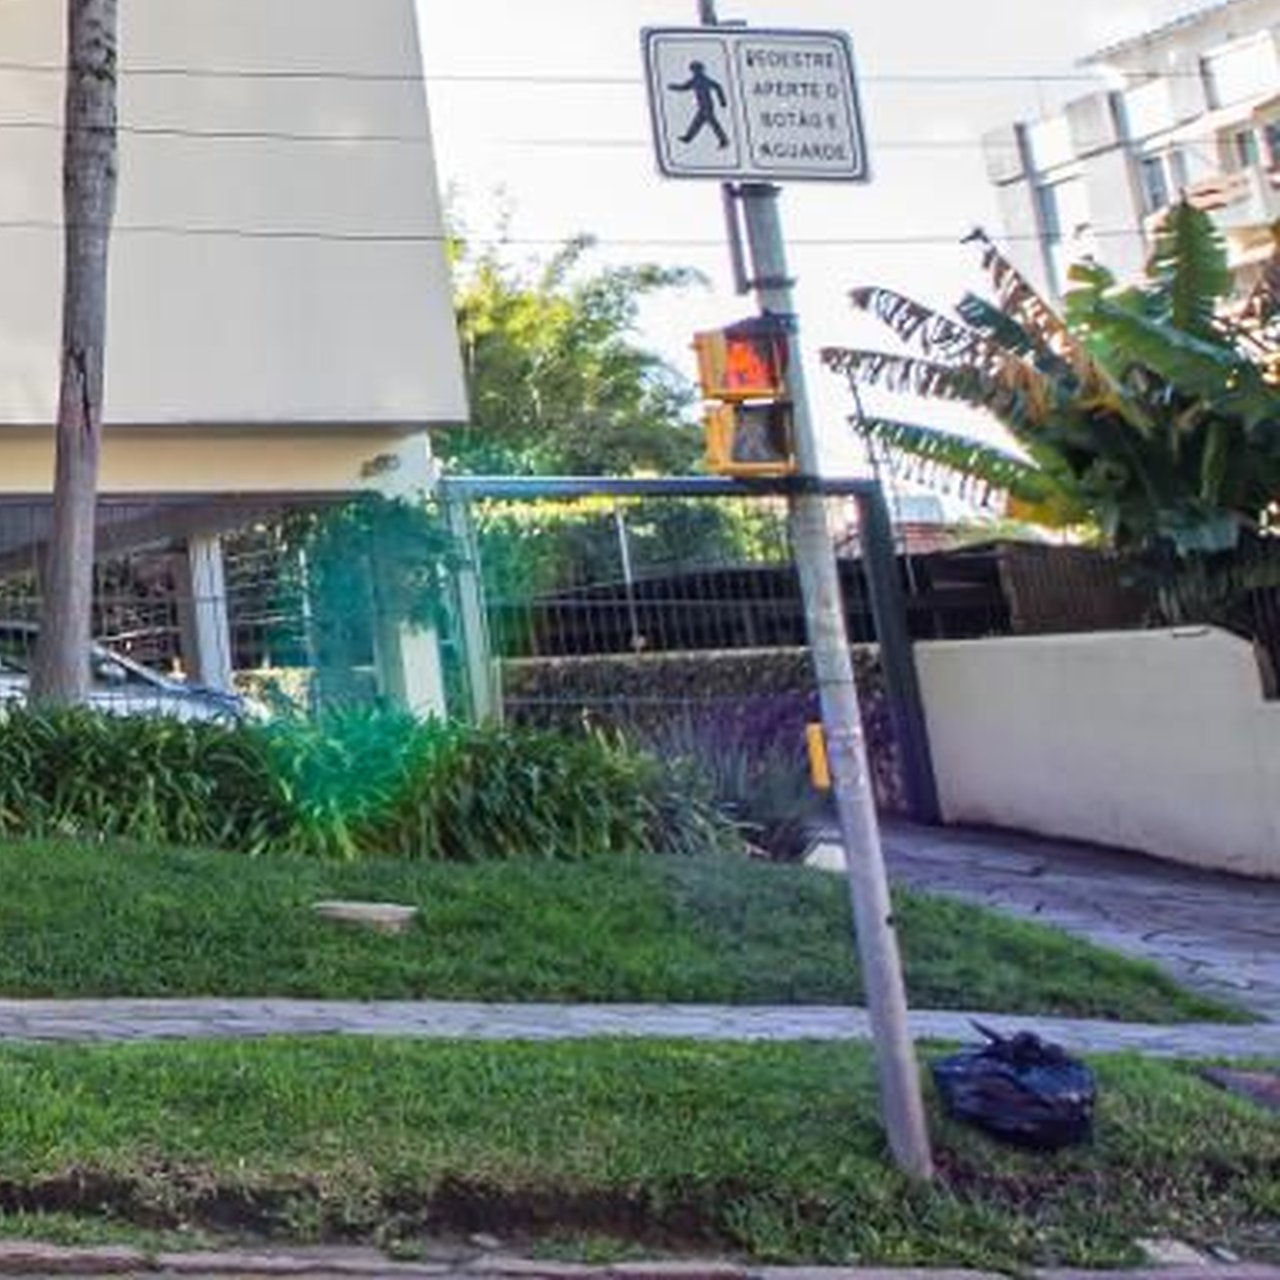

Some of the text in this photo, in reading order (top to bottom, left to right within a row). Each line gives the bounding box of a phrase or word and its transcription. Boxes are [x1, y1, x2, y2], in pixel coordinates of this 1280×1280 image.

[745, 49, 834, 69] PEDESTRE
[753, 81, 821, 99] APERTE
[759, 141, 848, 161] AGUARDE
